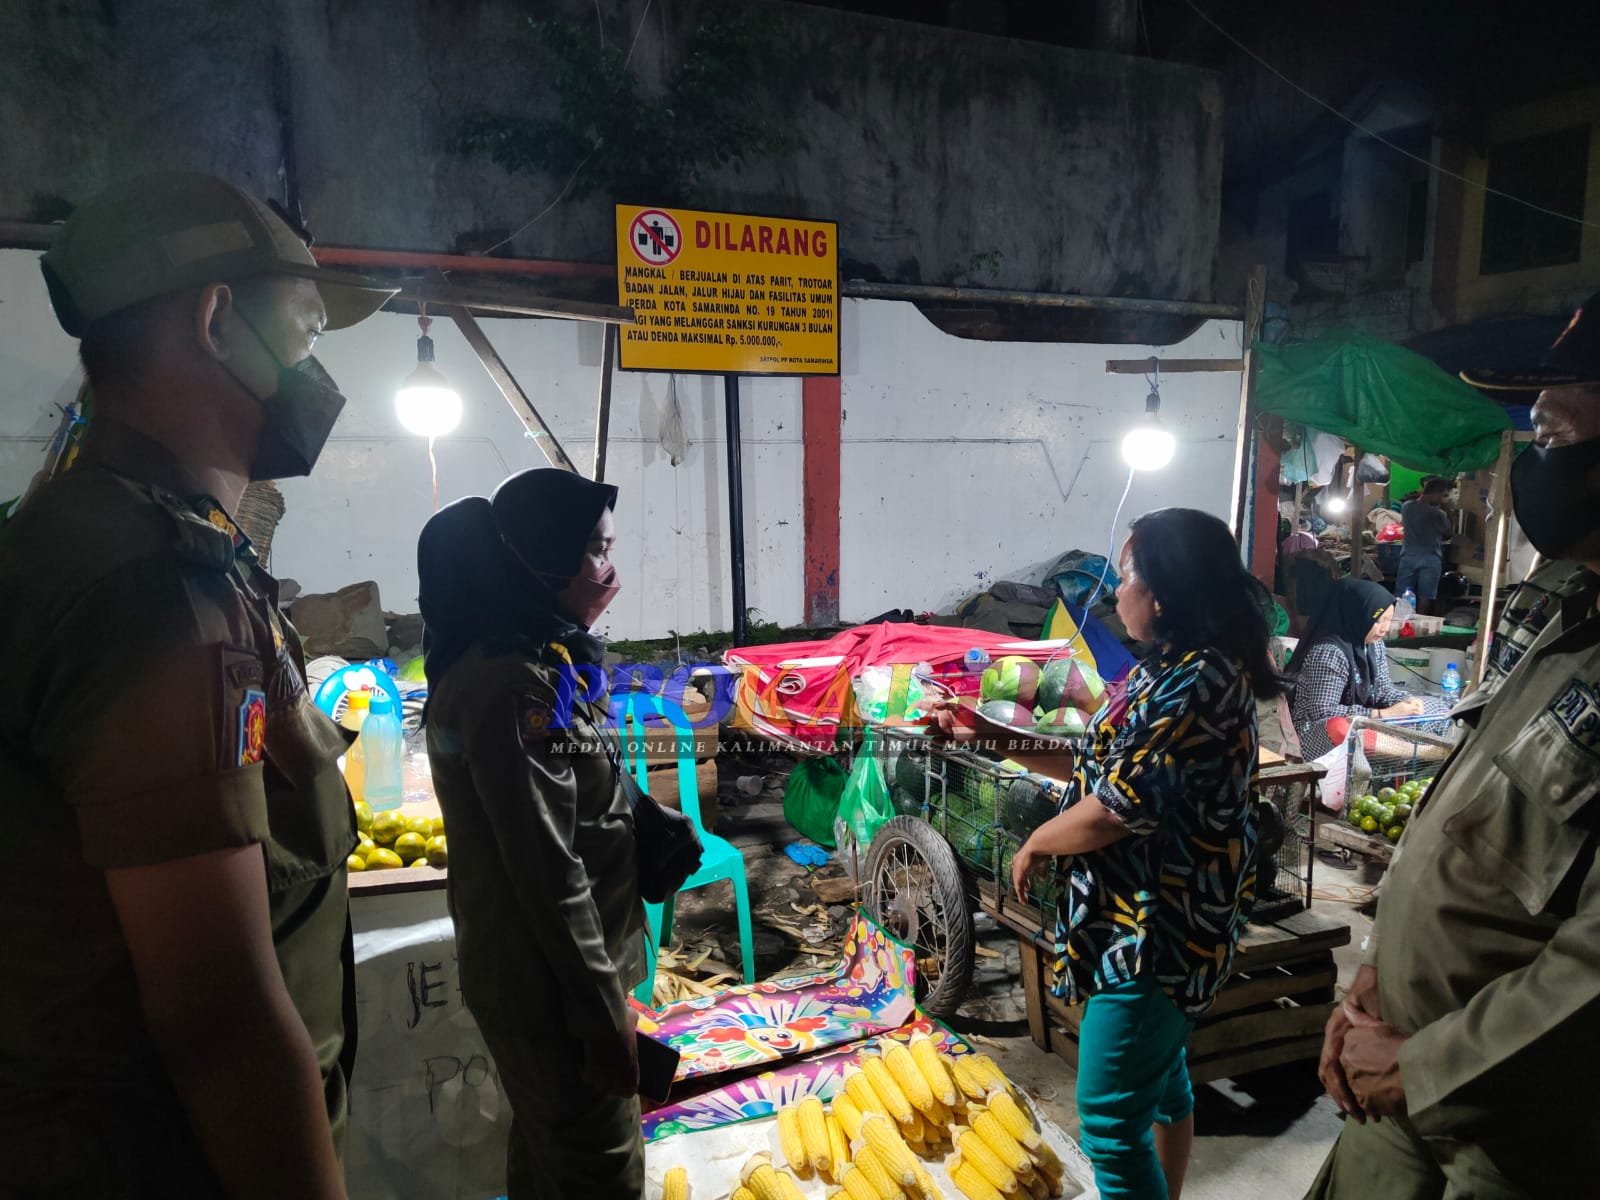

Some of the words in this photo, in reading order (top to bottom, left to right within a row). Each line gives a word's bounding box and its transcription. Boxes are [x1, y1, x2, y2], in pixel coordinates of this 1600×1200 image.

[695, 220, 828, 258] DILARANG
[625, 266, 667, 280] MANGKAL
[680, 270, 728, 283] BERJUALAN
[733, 273, 741, 284] DI
[746, 274, 766, 286] ATAS
[770, 276, 794, 289] PARIT,
[798, 278, 833, 290] TROTOAR
[625, 282, 654, 295] BADAN
[659, 284, 688, 299] JALAN,
[692, 286, 718, 298] JALUR
[722, 288, 746, 300] HIJAU
[749, 290, 765, 301] DAN
[769, 291, 807, 303] FASILITAS
[810, 293, 833, 305] UMUM
[663, 300, 686, 313] KOTA
[692, 302, 740, 315] SAMARINDA
[746, 304, 760, 316] NO.
[766, 306, 775, 317] 19
[781, 306, 807, 319] TAHUN
[812, 308, 833, 321] 2001)
[634, 314, 647, 326] AGI
[649, 315, 672, 327] YANG
[674, 317, 725, 330] MELANGGAR
[726, 319, 755, 331] SANKSI
[757, 320, 800, 333] KURUNGAN
[802, 322, 807, 333] 3
[808, 323, 833, 334] BULAN
[627, 330, 649, 342] ATAU
[651, 331, 679, 343] DENDA
[681, 332, 724, 345] MAKSIMAL
[725, 334, 738, 347] Rp.
